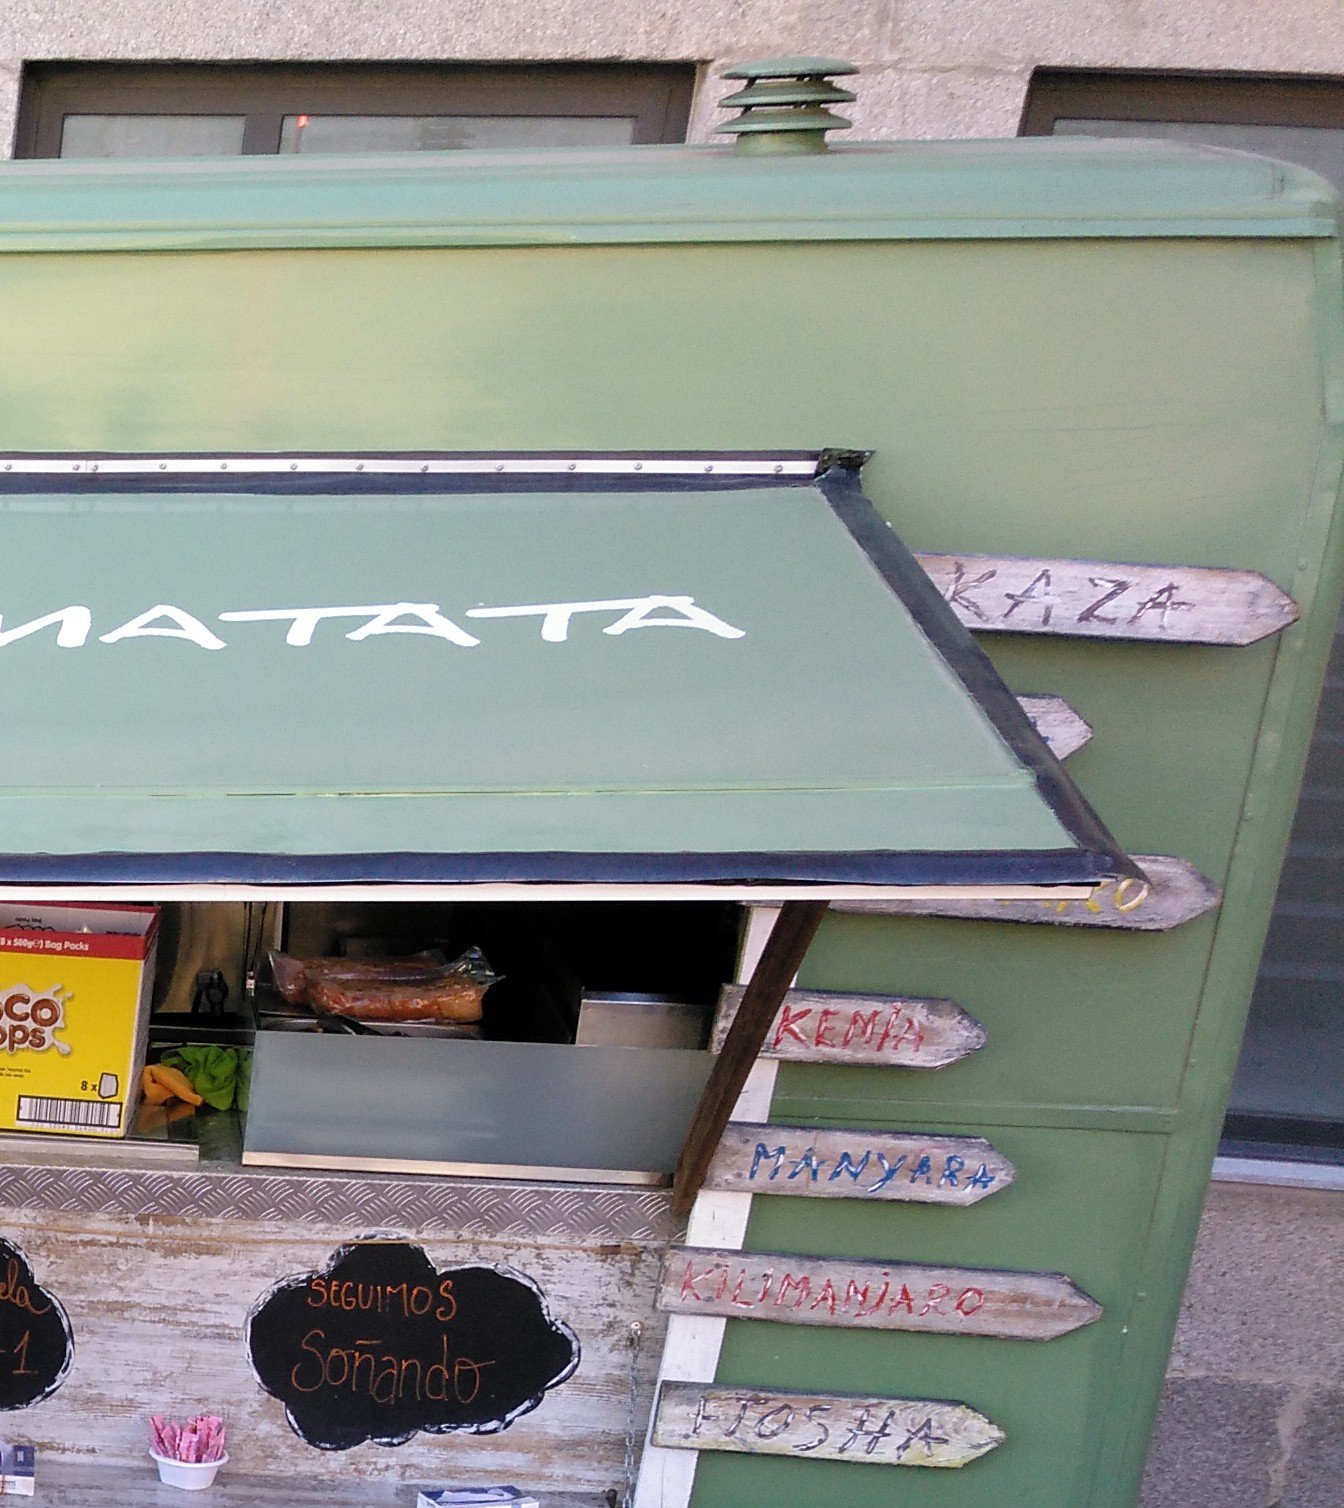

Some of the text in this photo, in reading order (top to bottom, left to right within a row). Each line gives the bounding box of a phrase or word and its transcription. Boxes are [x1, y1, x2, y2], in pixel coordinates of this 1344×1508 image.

[45, 940, 62, 950] Bag
[64, 941, 89, 951] Packs
[80, 1080, 88, 1091] 8
[748, 1142, 995, 1194] MANYARA
[307, 1278, 458, 1321] SEGUIMOS
[681, 1260, 984, 1318] KILIMANJARO
[291, 1329, 496, 1404] Soñando
